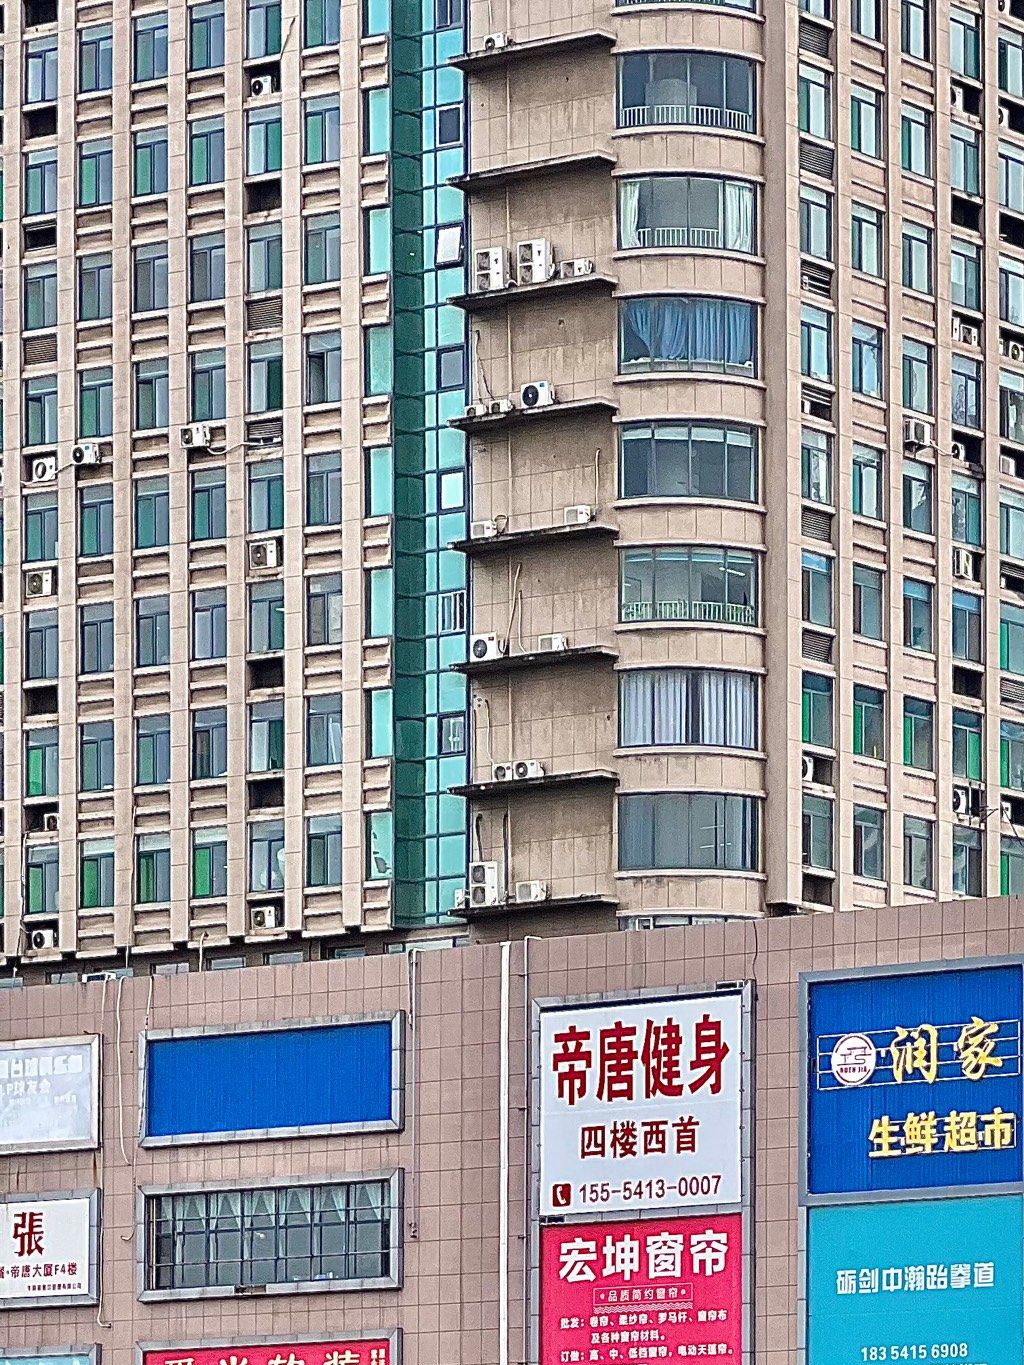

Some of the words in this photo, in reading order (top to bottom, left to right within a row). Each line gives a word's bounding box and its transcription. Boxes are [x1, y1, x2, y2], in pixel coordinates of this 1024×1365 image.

[552, 1014, 730, 1105] 帝唐健身
[890, 1016, 1003, 1084] 润家
[580, 1115, 700, 1159] 四楼西首
[868, 1107, 1015, 1157] 生鲜超市
[578, 1175, 722, 1203] 155-5413-0007
[12, 1212, 44, 1257] 張
[559, 1229, 728, 1283] 宏坤窗帘
[608, 1287, 678, 1301] 品质简约窗帘
[836, 1262, 994, 1295] 砺剑中瀚跆拳道
[861, 1347, 886, 1361] 183
[891, 1345, 927, 1360] 5415
[931, 1343, 968, 1358] 6908
